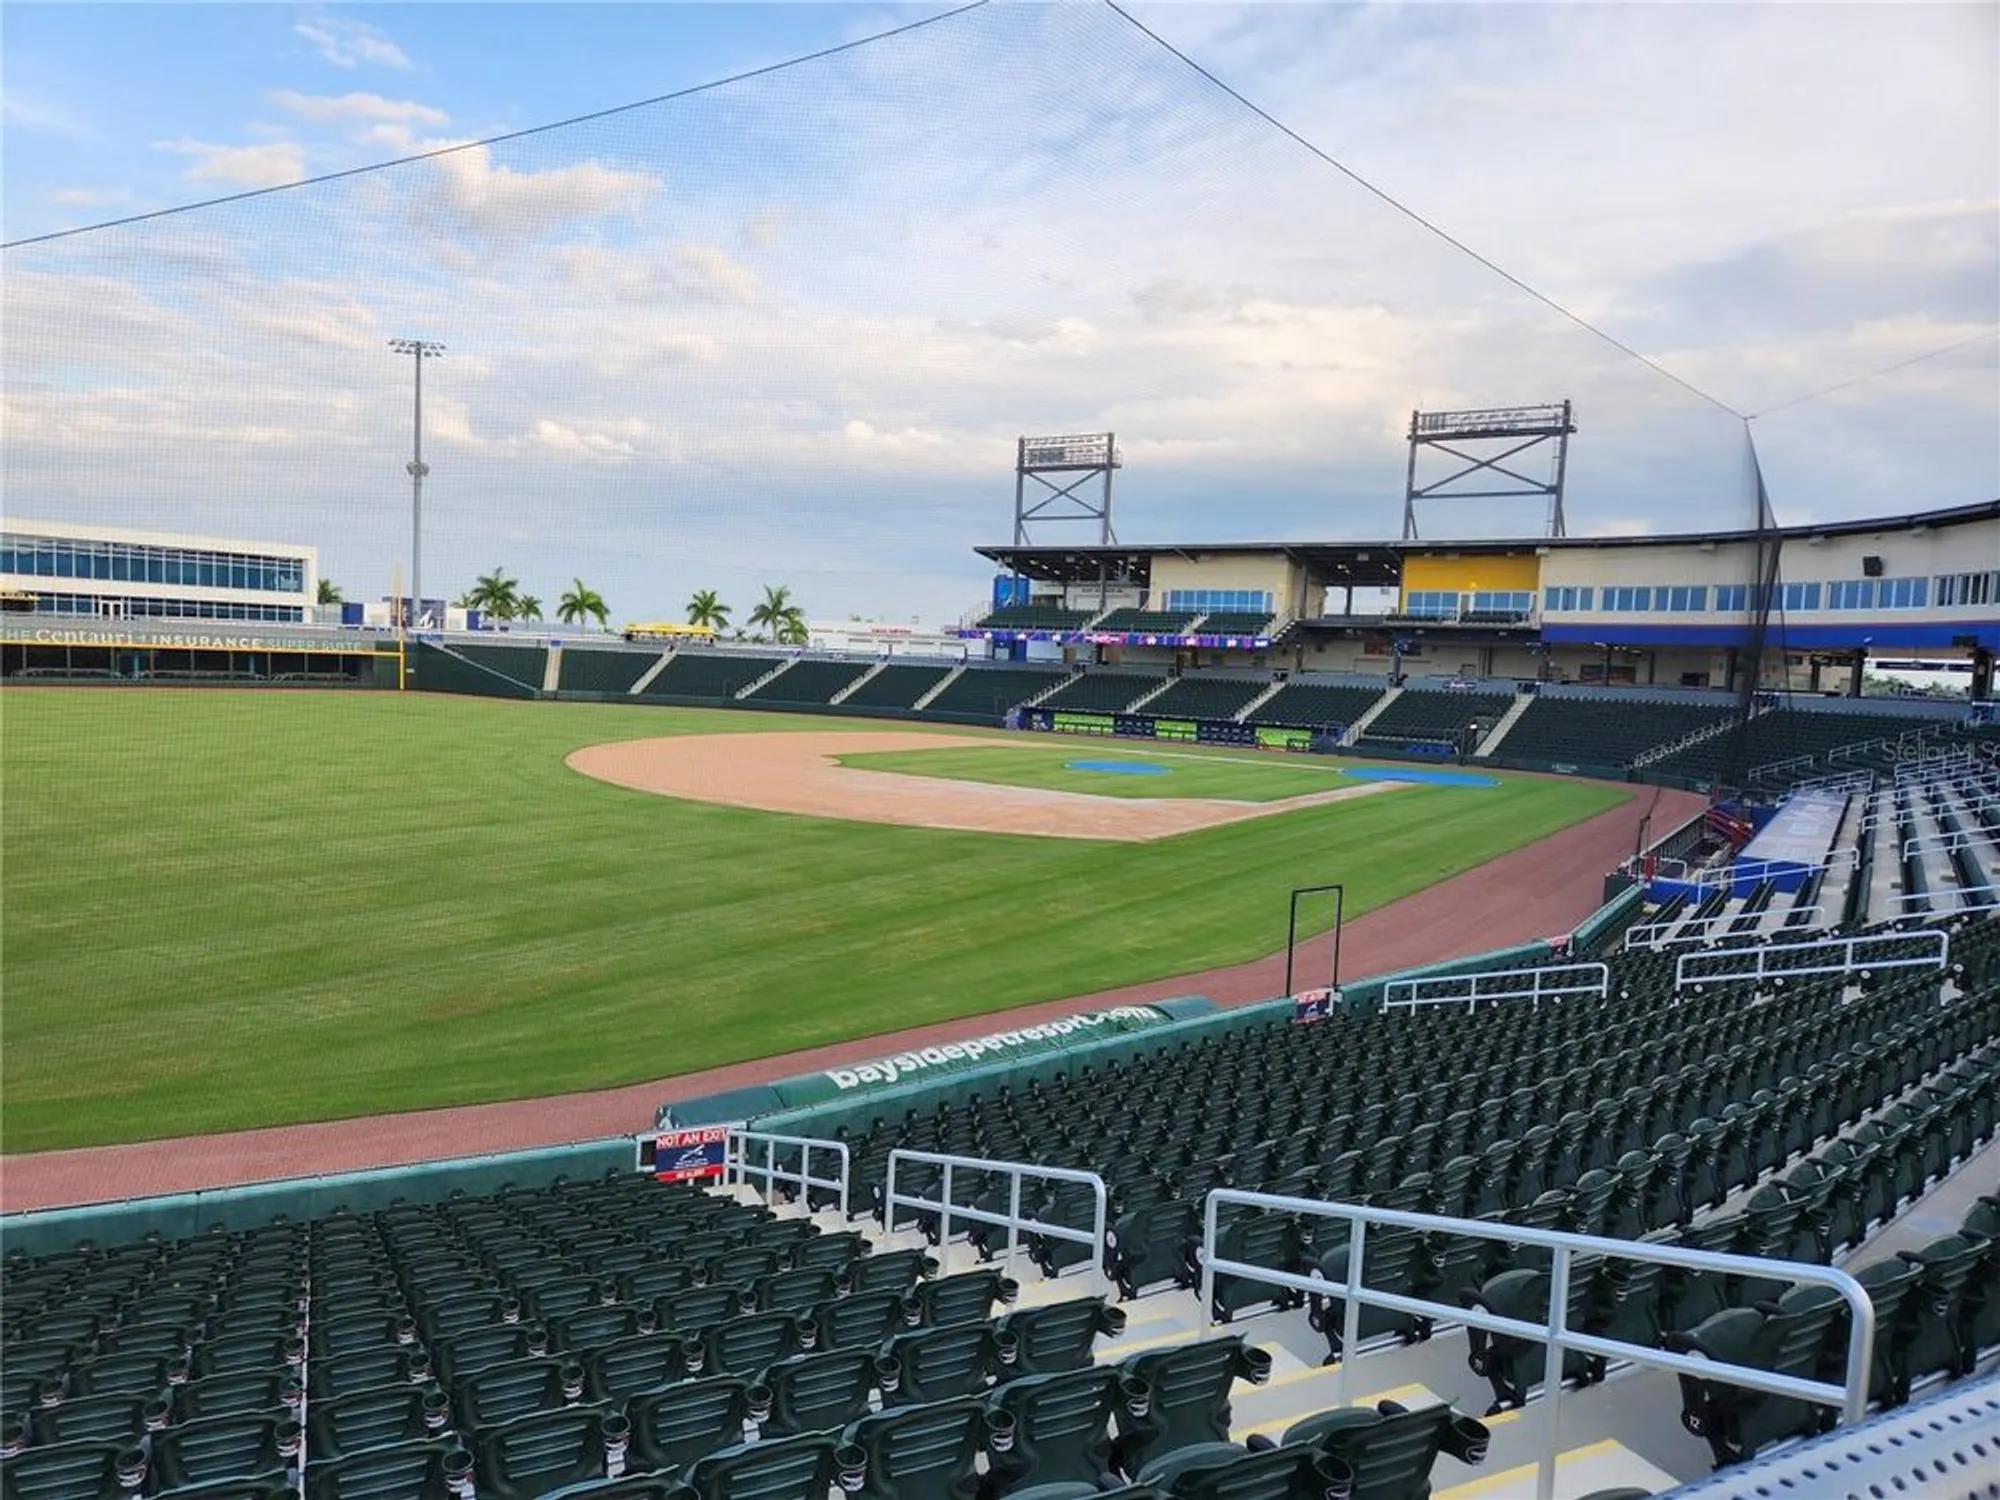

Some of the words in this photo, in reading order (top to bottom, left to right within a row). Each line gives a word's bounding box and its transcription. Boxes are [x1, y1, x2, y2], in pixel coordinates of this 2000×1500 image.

[36, 628, 133, 645] Centauri
[152, 633, 262, 649] INSURANCE
[824, 1004, 1161, 1089] baysidepetresort.com
[656, 1133, 681, 1149] NOT
[681, 1131, 701, 1146] AN
[702, 1127, 728, 1142] EXIT
